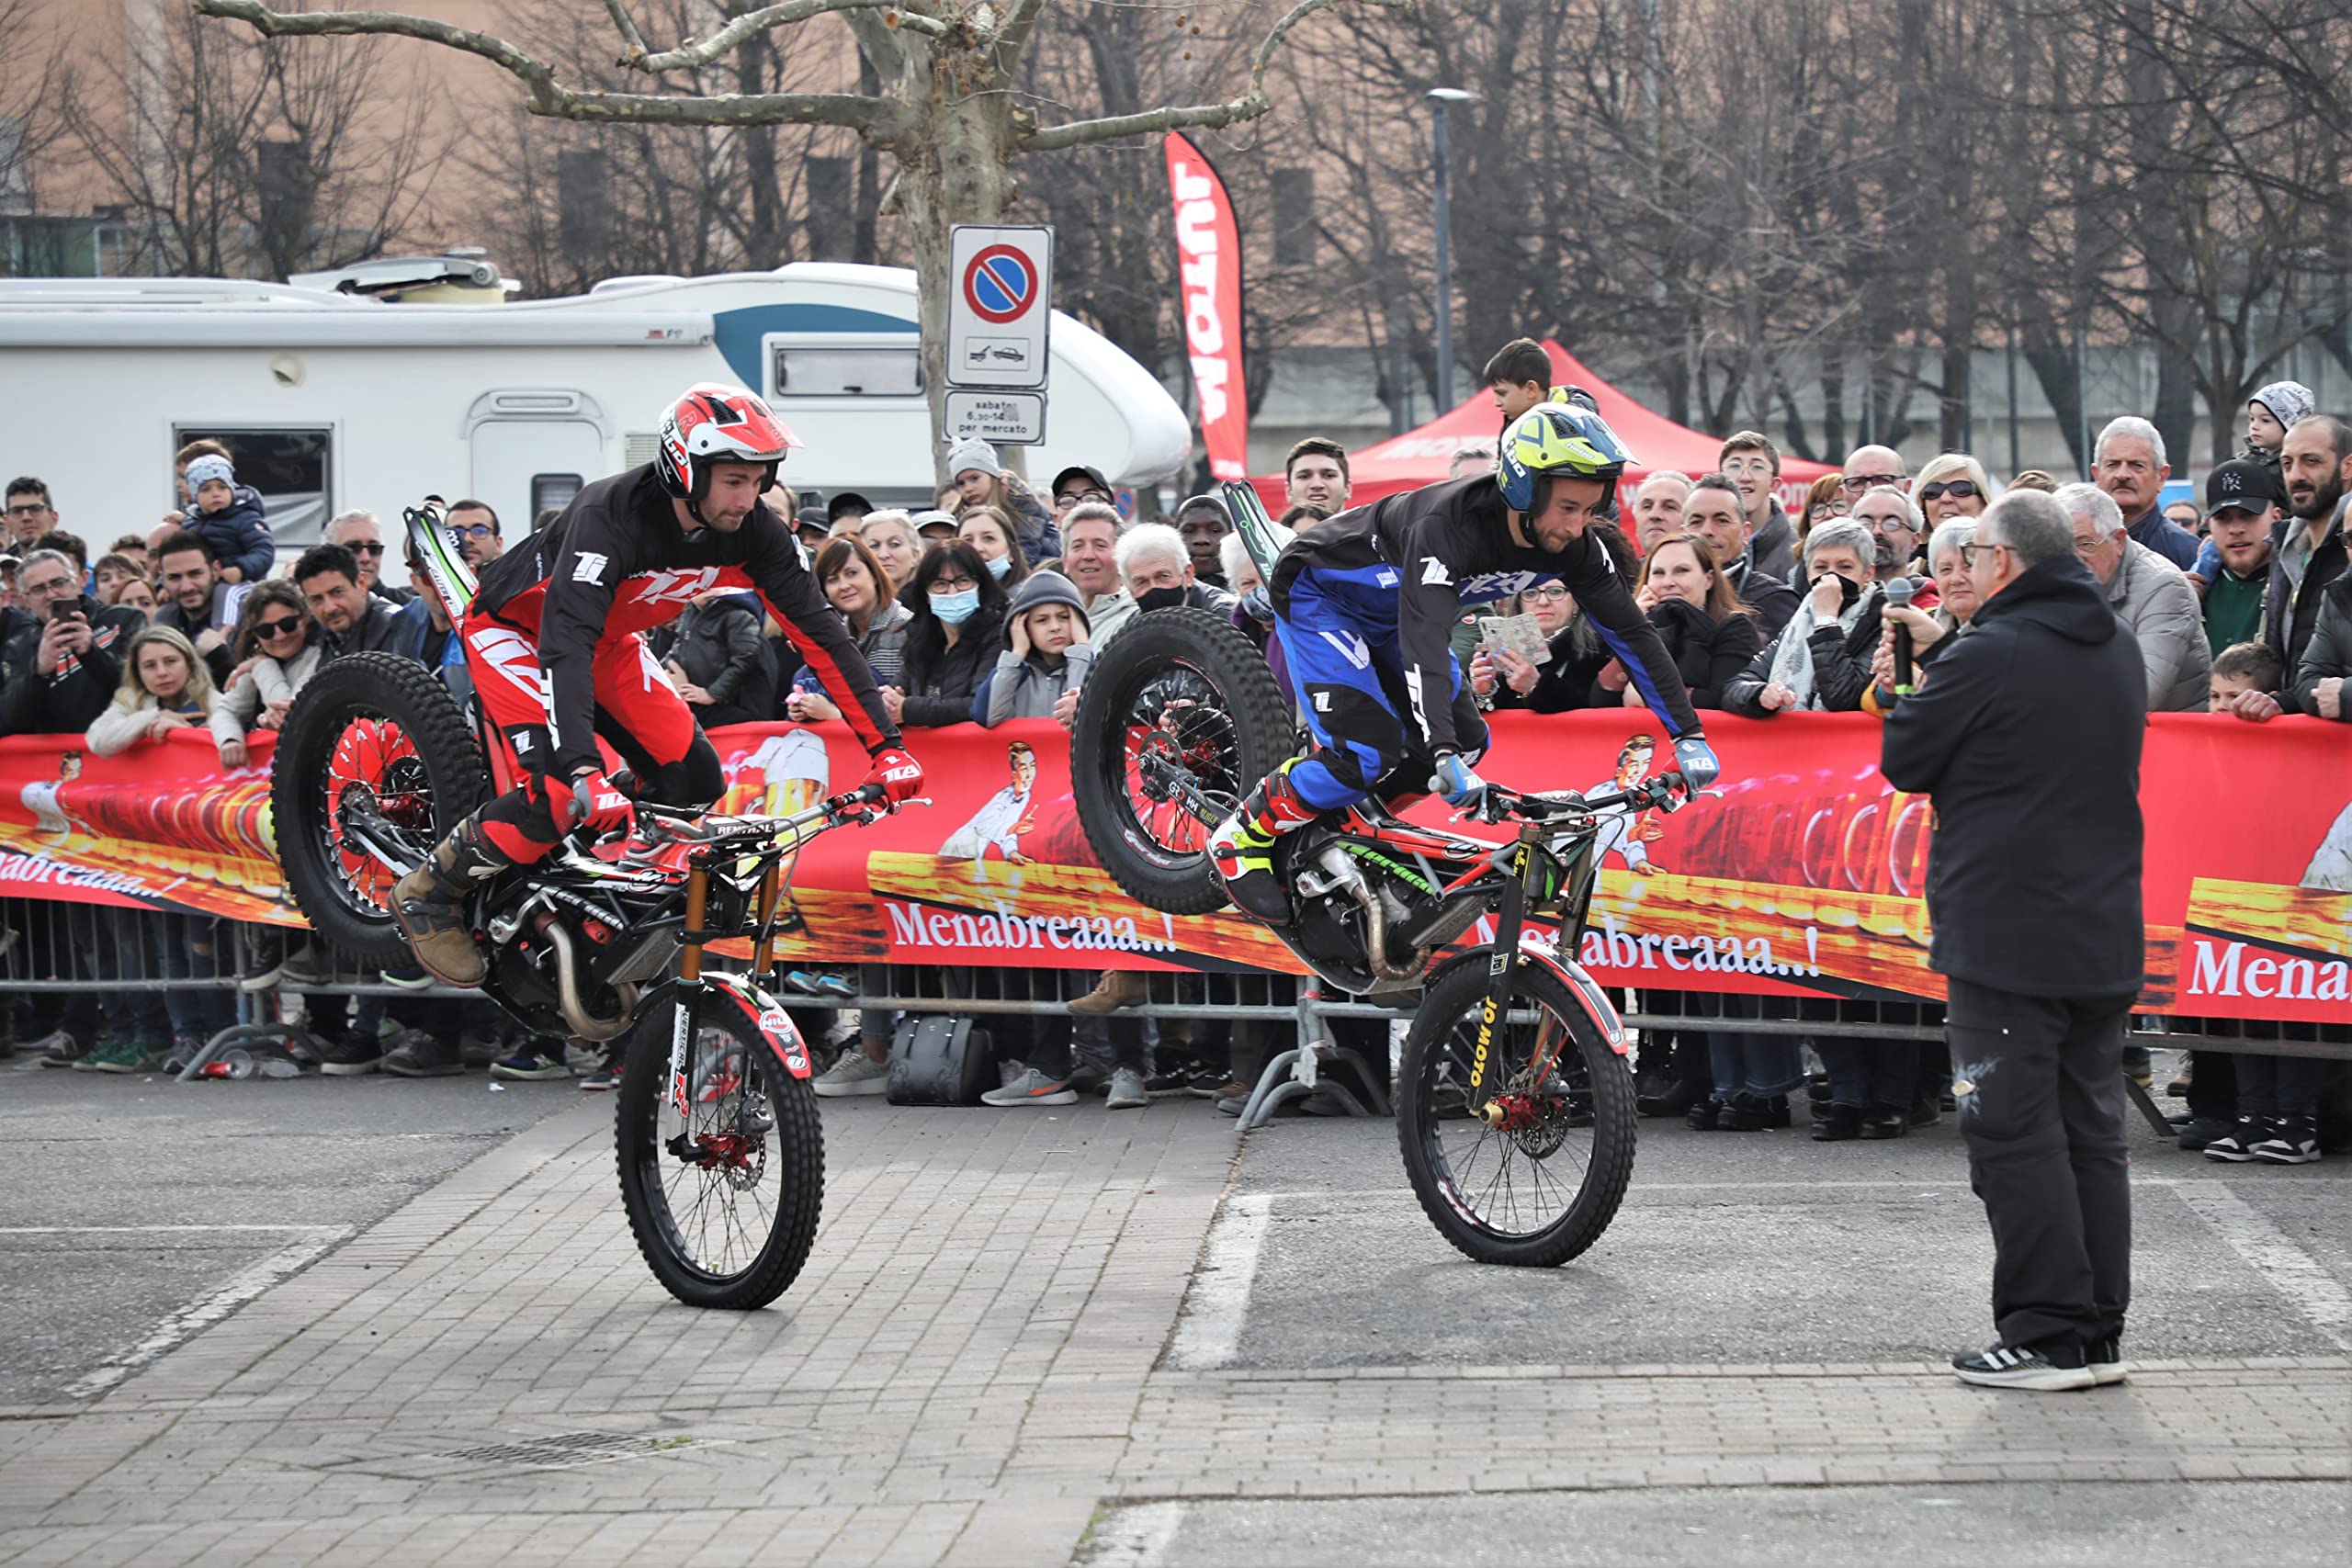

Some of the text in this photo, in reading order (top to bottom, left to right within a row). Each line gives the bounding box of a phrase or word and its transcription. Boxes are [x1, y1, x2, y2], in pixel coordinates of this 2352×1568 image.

[958, 423, 1028, 434] per mercato
[2187, 940, 2352, 1002] Mena
[1470, 1023, 1493, 1089] MOTO
